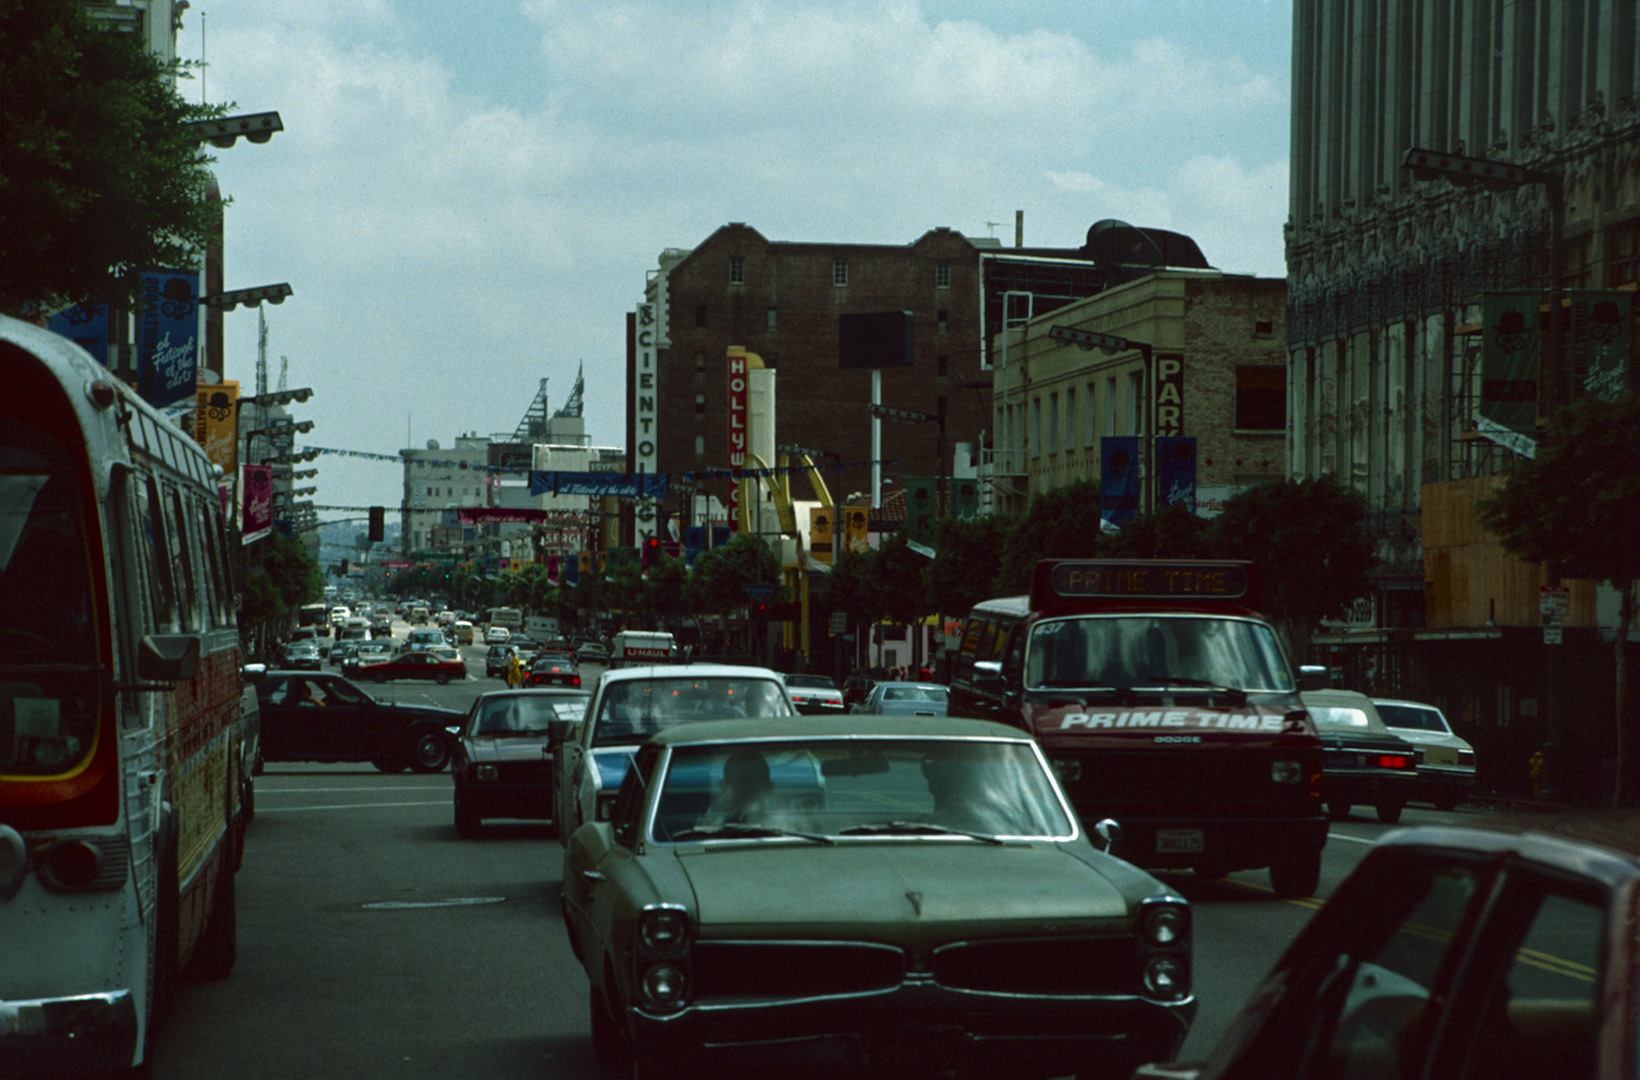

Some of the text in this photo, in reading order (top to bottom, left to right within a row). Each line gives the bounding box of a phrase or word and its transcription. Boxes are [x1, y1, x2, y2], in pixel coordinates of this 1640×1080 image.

[638, 304, 655, 541] SCIENTOGY
[1069, 570, 1228, 593] PRIME TIME
[627, 648, 667, 657] U-HAUL
[1060, 711, 1285, 731] PRIME TIME
[1153, 735, 1202, 744] DODGE
